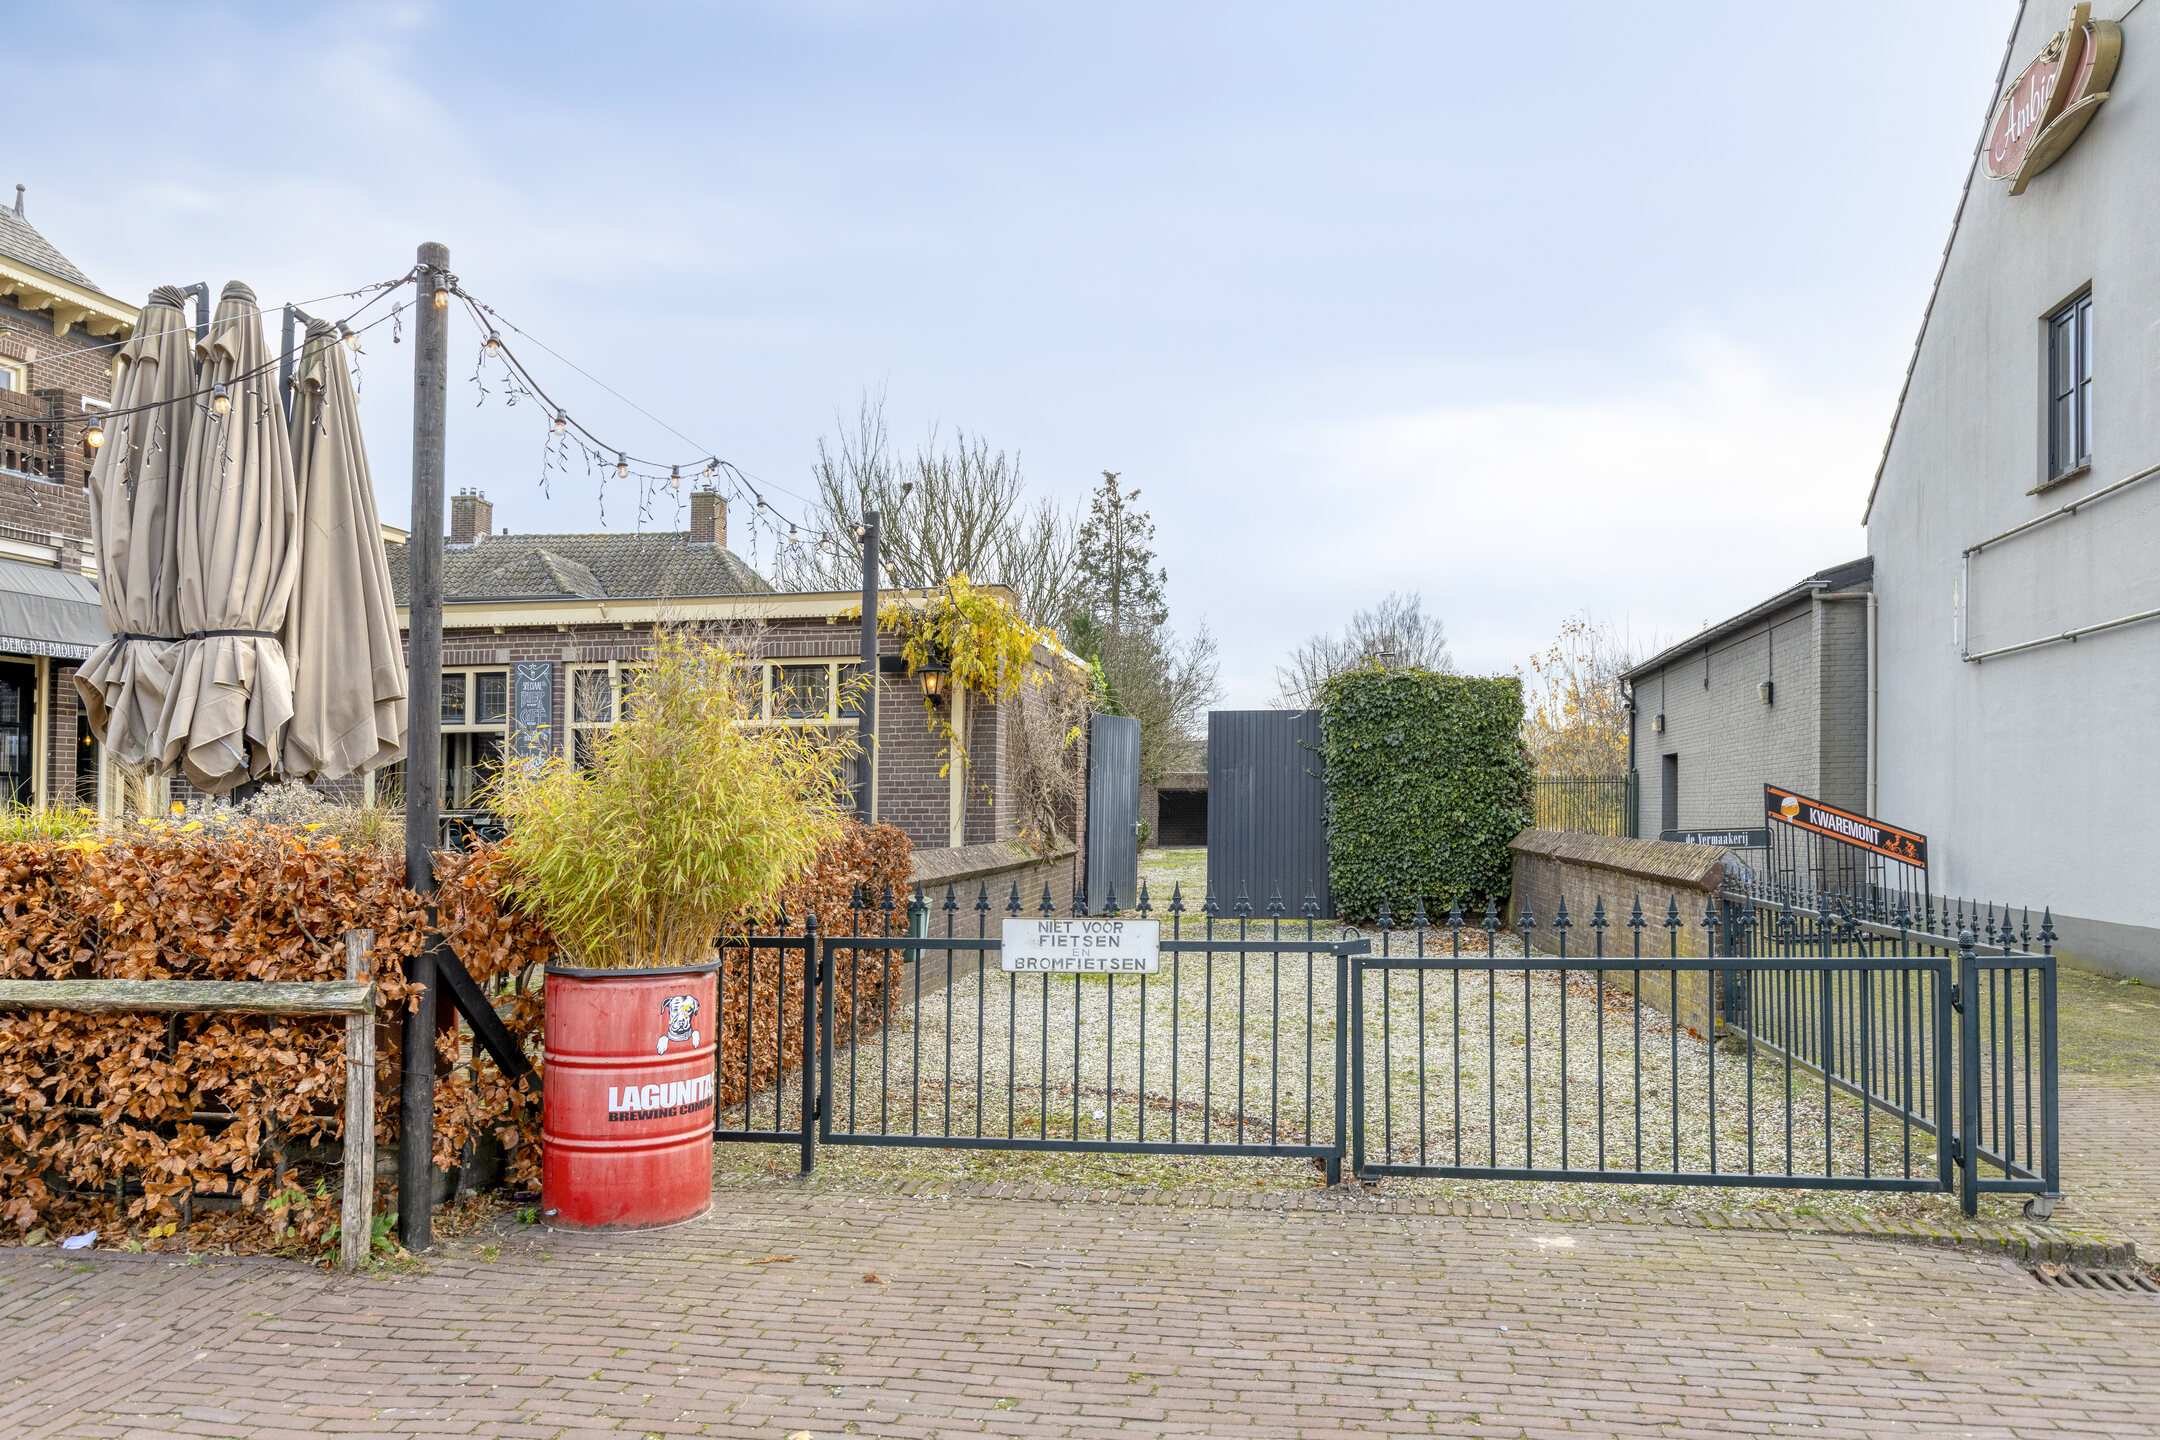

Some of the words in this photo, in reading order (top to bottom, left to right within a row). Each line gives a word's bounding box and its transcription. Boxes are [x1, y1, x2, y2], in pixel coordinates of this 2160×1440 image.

[0, 637, 27, 653] BERG
[30, 640, 46, 655] D'N
[1809, 807, 1881, 846] KWAREMONT
[1685, 833, 1695, 845] de
[1697, 831, 1749, 846] Vermaakerij
[1038, 921, 1073, 934] NIET
[1082, 921, 1124, 934] VOOR
[1039, 935, 1120, 948] FIETSEN
[1072, 948, 1090, 957] EN
[1014, 957, 1147, 971] BROMFIETSEN
[608, 1106, 678, 1122] BREWING
